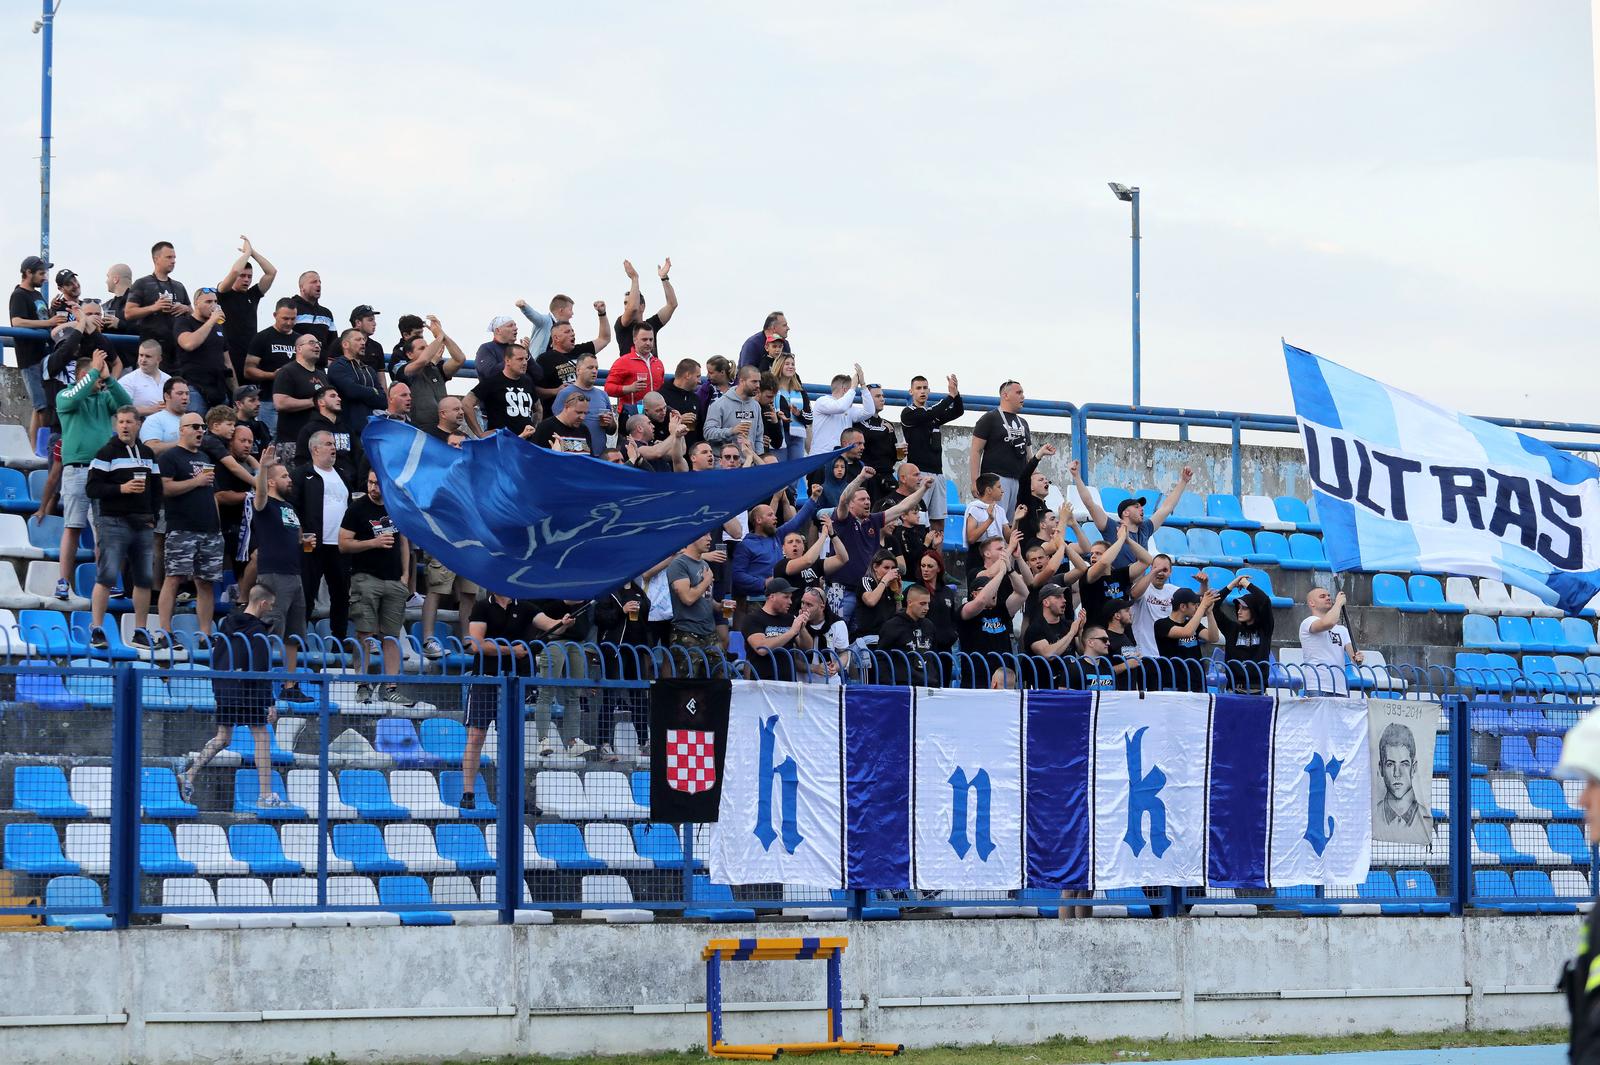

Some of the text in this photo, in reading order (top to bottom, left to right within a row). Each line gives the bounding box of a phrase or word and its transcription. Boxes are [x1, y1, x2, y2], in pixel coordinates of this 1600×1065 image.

[505, 387, 533, 418] ŠČ!
[1303, 423, 1584, 571] ULTRAS
[1383, 703, 1423, 719] 1989-2011
